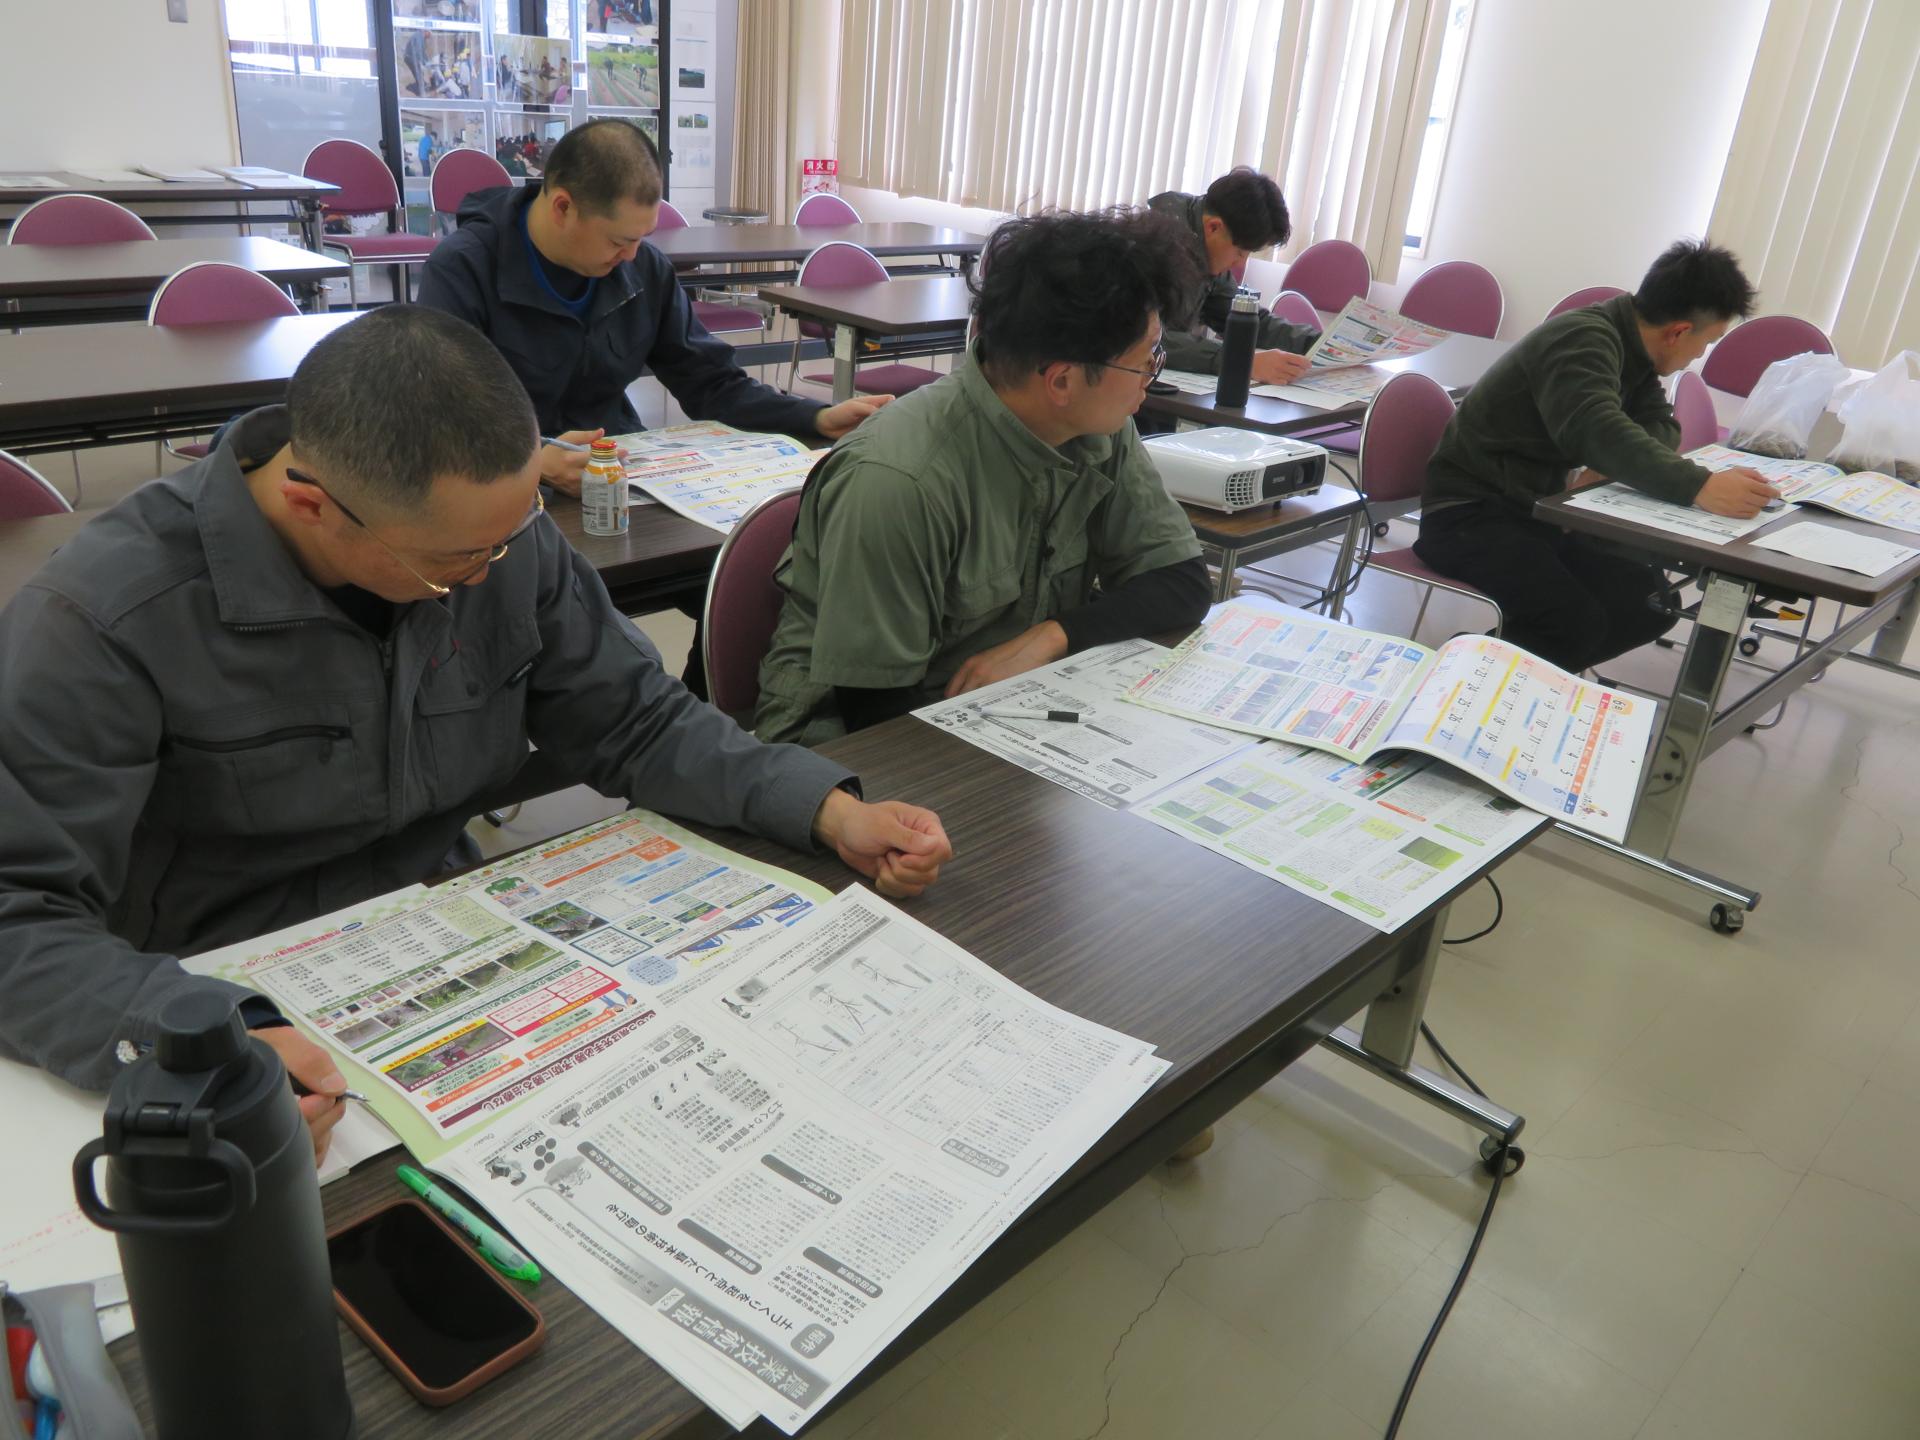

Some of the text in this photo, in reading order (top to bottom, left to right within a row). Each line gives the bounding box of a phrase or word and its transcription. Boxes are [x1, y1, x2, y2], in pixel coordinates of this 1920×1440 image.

[510, 1128, 546, 1153] NOSAI
[602, 1200, 796, 1333] 土づくりを起点とした基本技術の励行を
[668, 1299, 813, 1402] 農業技術情報
[795, 1325, 829, 1355] 稲作
